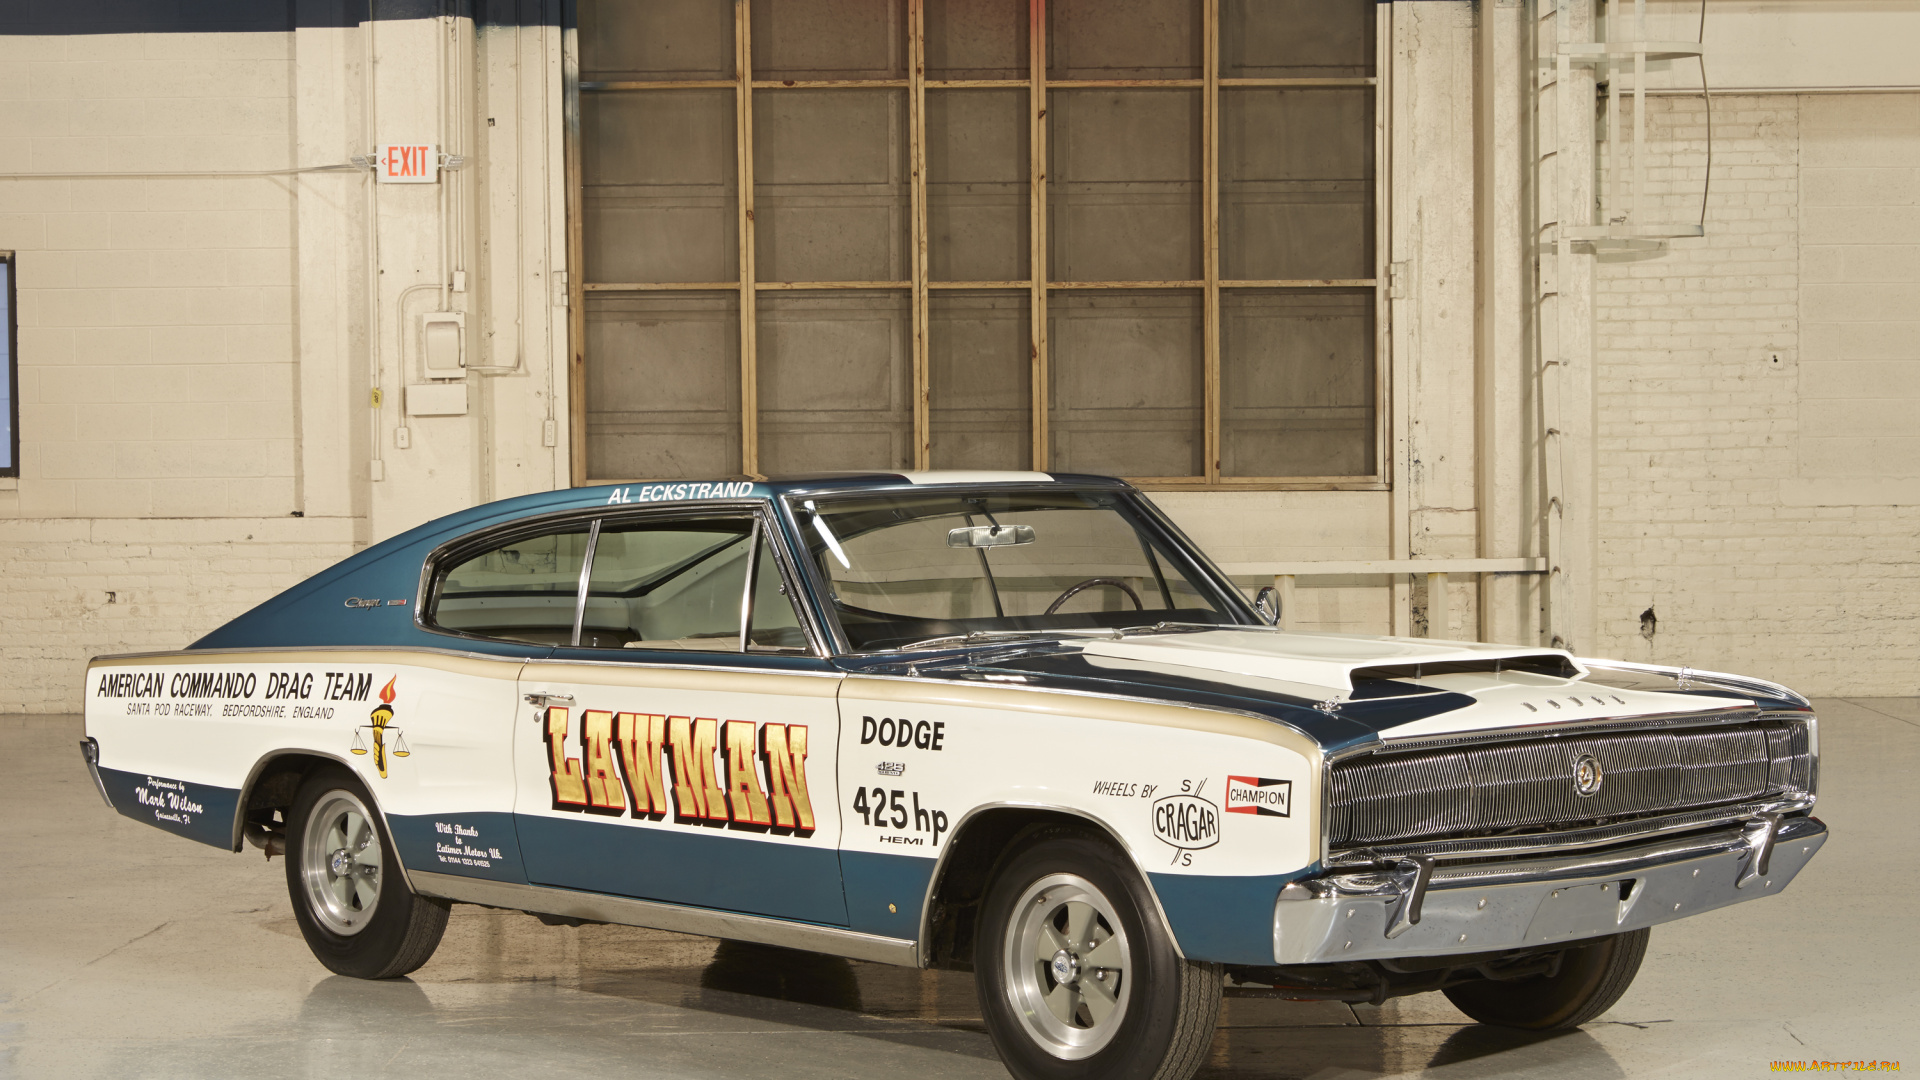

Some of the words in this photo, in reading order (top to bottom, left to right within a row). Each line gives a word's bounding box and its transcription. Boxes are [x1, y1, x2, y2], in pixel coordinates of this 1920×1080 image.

[388, 146, 429, 176] EXIT
[607, 487, 632, 504] AL
[639, 481, 754, 502] ECKSTRAND
[97, 672, 165, 698] AMERICAN
[170, 672, 257, 699] COMMANDO
[265, 672, 314, 700] DRAG
[324, 672, 373, 702] TEAM
[126, 702, 151, 716] SANTA
[154, 703, 171, 716] POD
[292, 706, 335, 720] ENGLAND
[860, 715, 945, 751] DODGE
[543, 706, 816, 839] LAWMAN
[147, 776, 177, 789] Performance
[179, 781, 185, 793] by
[1093, 780, 1137, 797] WHEELS
[1141, 784, 1158, 799] BY
[135, 787, 165, 807] Mark
[168, 792, 203, 813] Wilson
[1230, 788, 1285, 806] CHAMPION
[853, 786, 908, 830] 425
[912, 791, 948, 846] hp
[1156, 802, 1216, 842] CRAGAR
[435, 822, 453, 834] With
[454, 824, 478, 837] Thanks
[455, 836, 462, 844] to
[436, 842, 463, 855] Latimer
[463, 845, 487, 858] Motors
[879, 835, 924, 846] HEMI
